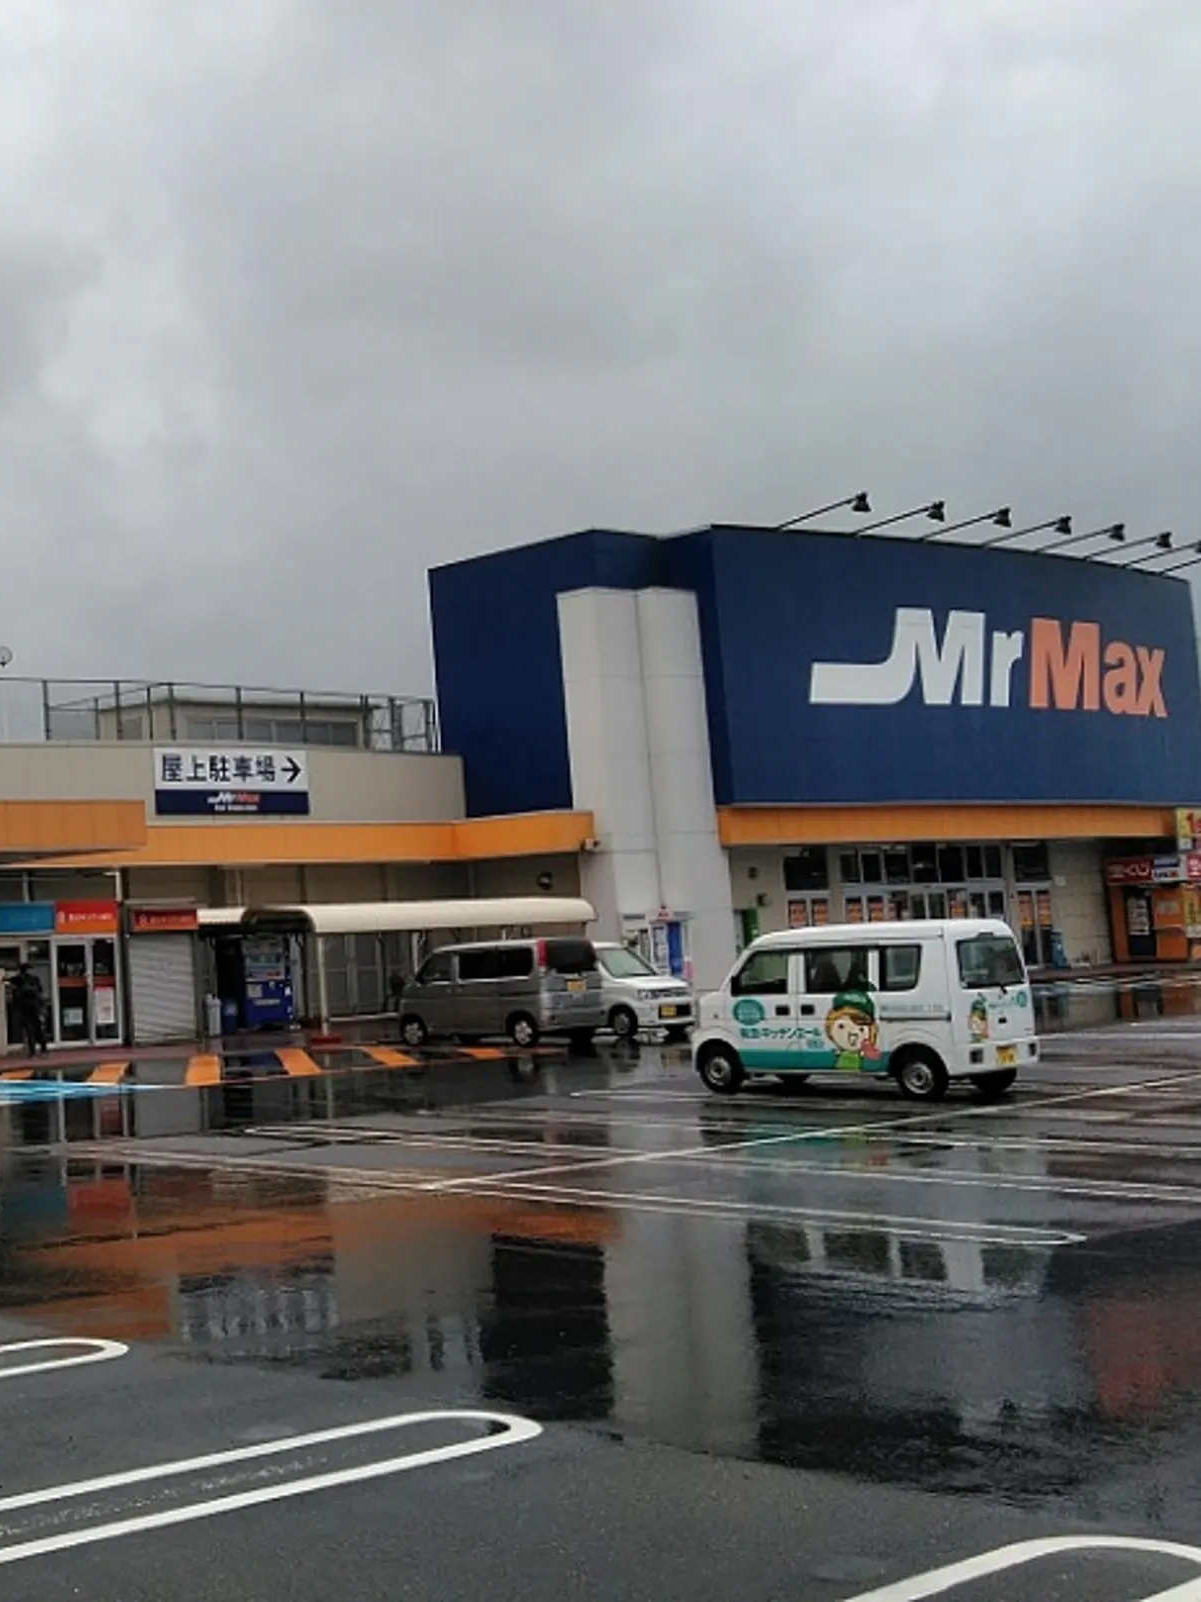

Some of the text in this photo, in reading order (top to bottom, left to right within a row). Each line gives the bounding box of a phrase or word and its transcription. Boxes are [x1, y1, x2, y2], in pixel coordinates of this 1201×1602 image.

[809, 606, 1168, 718] MrMax
[161, 753, 276, 783] 屋上駐車場
